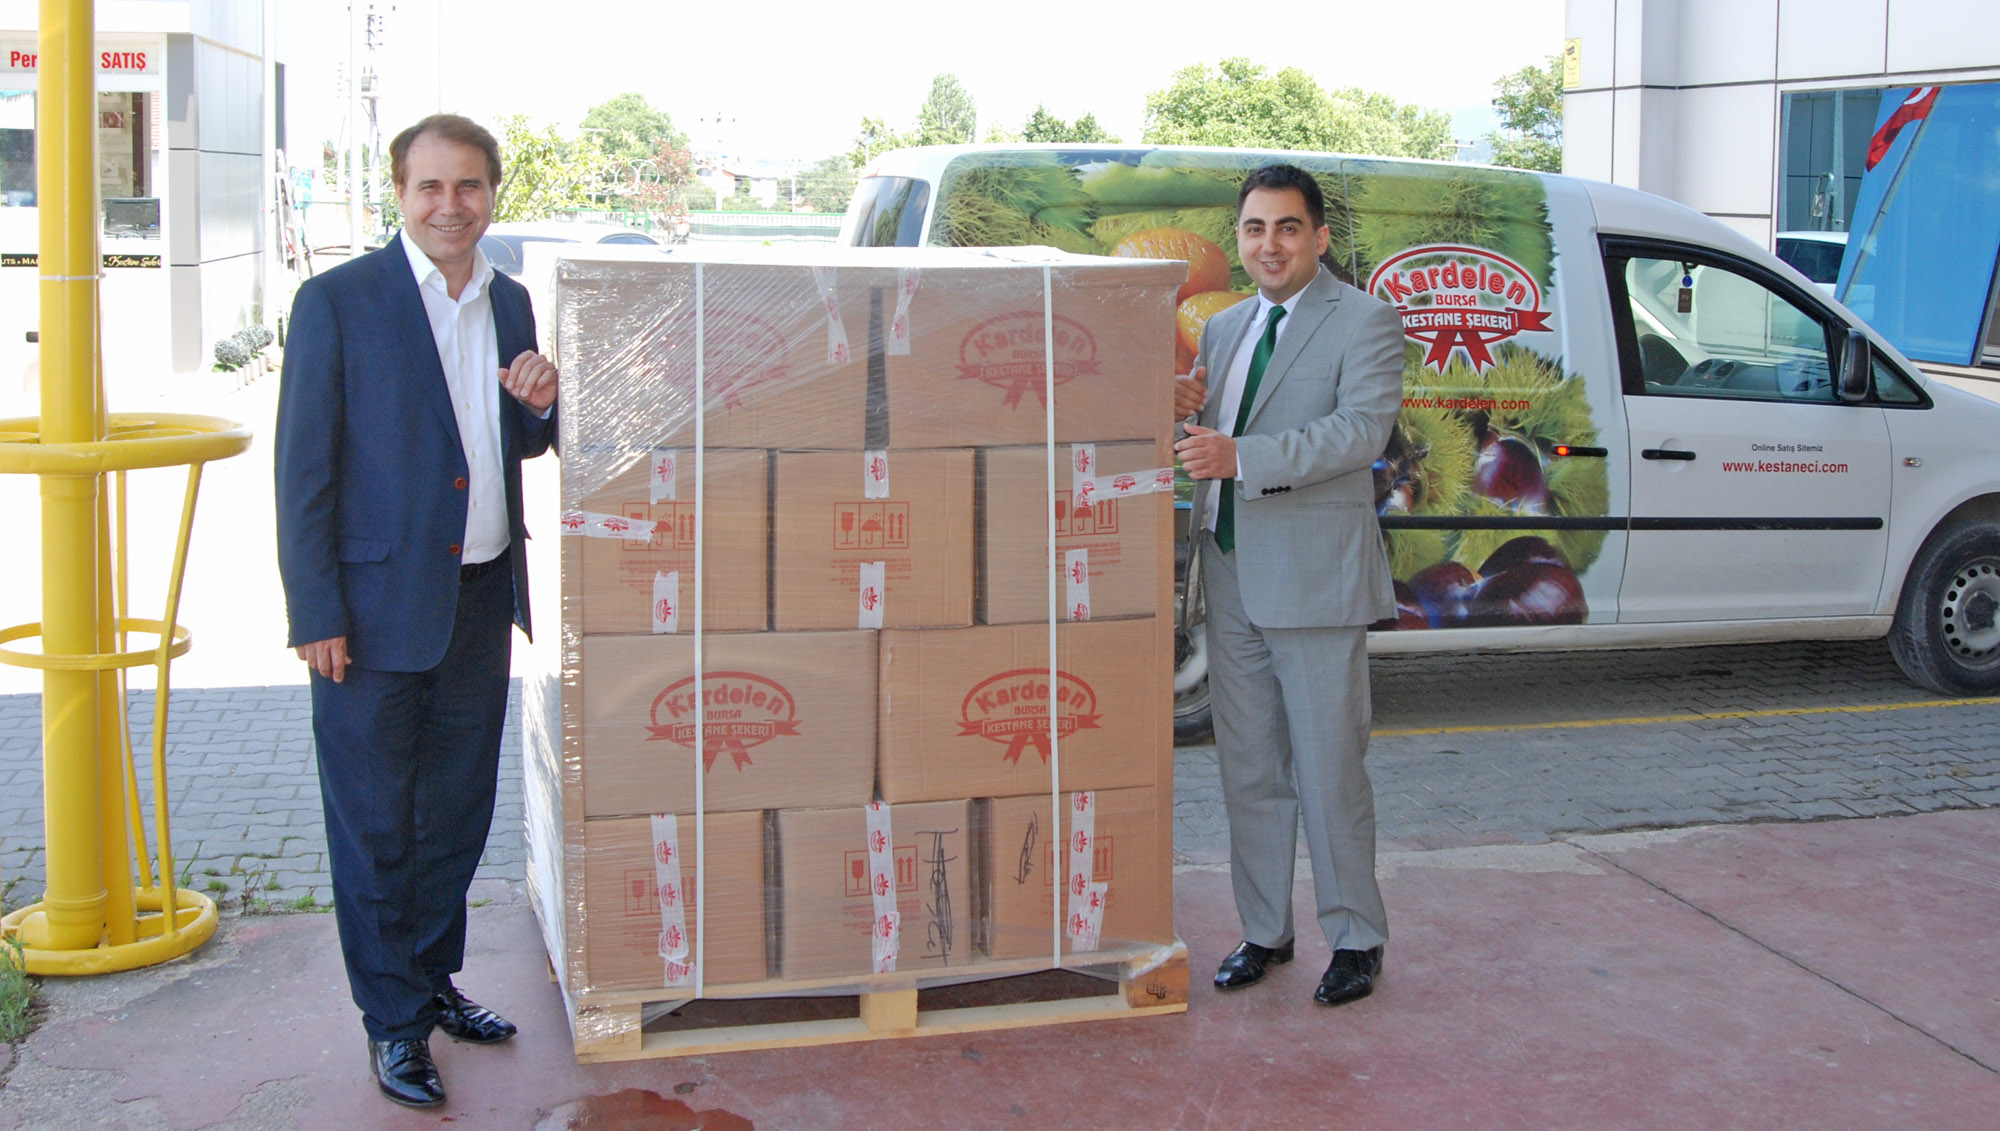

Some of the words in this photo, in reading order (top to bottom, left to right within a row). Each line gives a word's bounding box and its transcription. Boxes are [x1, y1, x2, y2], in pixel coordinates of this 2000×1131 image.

[101, 51, 147, 71] SATIŞ
[1384, 260, 1527, 304] Kardelen
[1435, 293, 1477, 307] BURSA
[1402, 312, 1462, 328] KESTANE
[1465, 312, 1513, 331] ŞEKERİ
[1401, 396, 1531, 410] www.kardelen.com
[1751, 443, 1775, 452] Online
[1777, 443, 1795, 453] Satış
[1797, 443, 1823, 452] Sitemiz
[1722, 460, 1848, 473] www.kestaneci.com
[974, 679, 1087, 715] Kardeen
[706, 709, 742, 721] BURSA
[1013, 705, 1047, 716] BURSA
[677, 724, 728, 739] KESANE
[986, 719, 1033, 734] KESTANE
